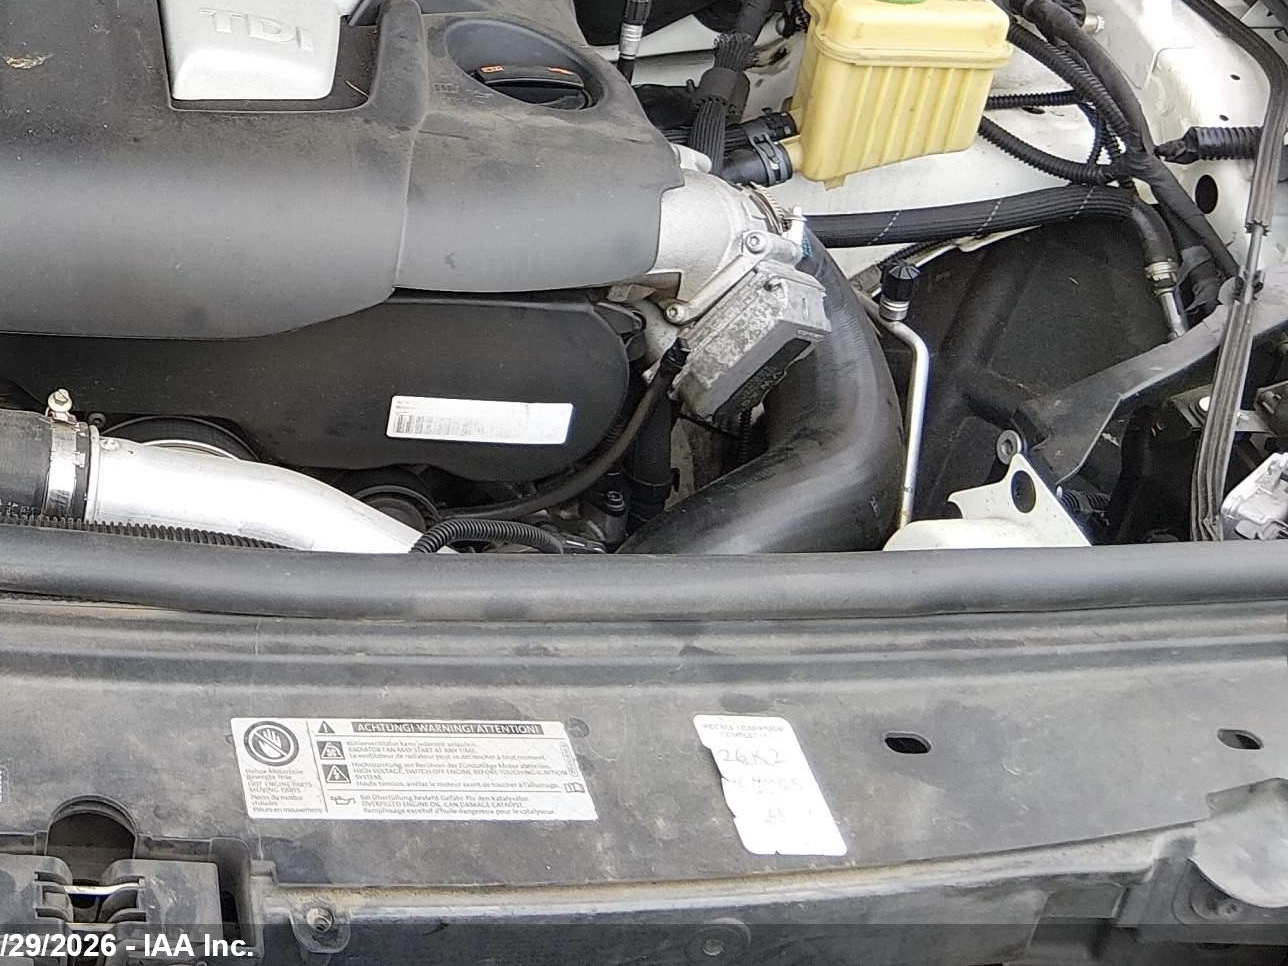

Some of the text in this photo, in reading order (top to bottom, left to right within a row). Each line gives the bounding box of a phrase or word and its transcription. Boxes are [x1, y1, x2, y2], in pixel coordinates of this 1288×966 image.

[199, 7, 314, 52] TDI
[355, 722, 539, 733] ACHTUNG! WARNING! ATTENTION!
